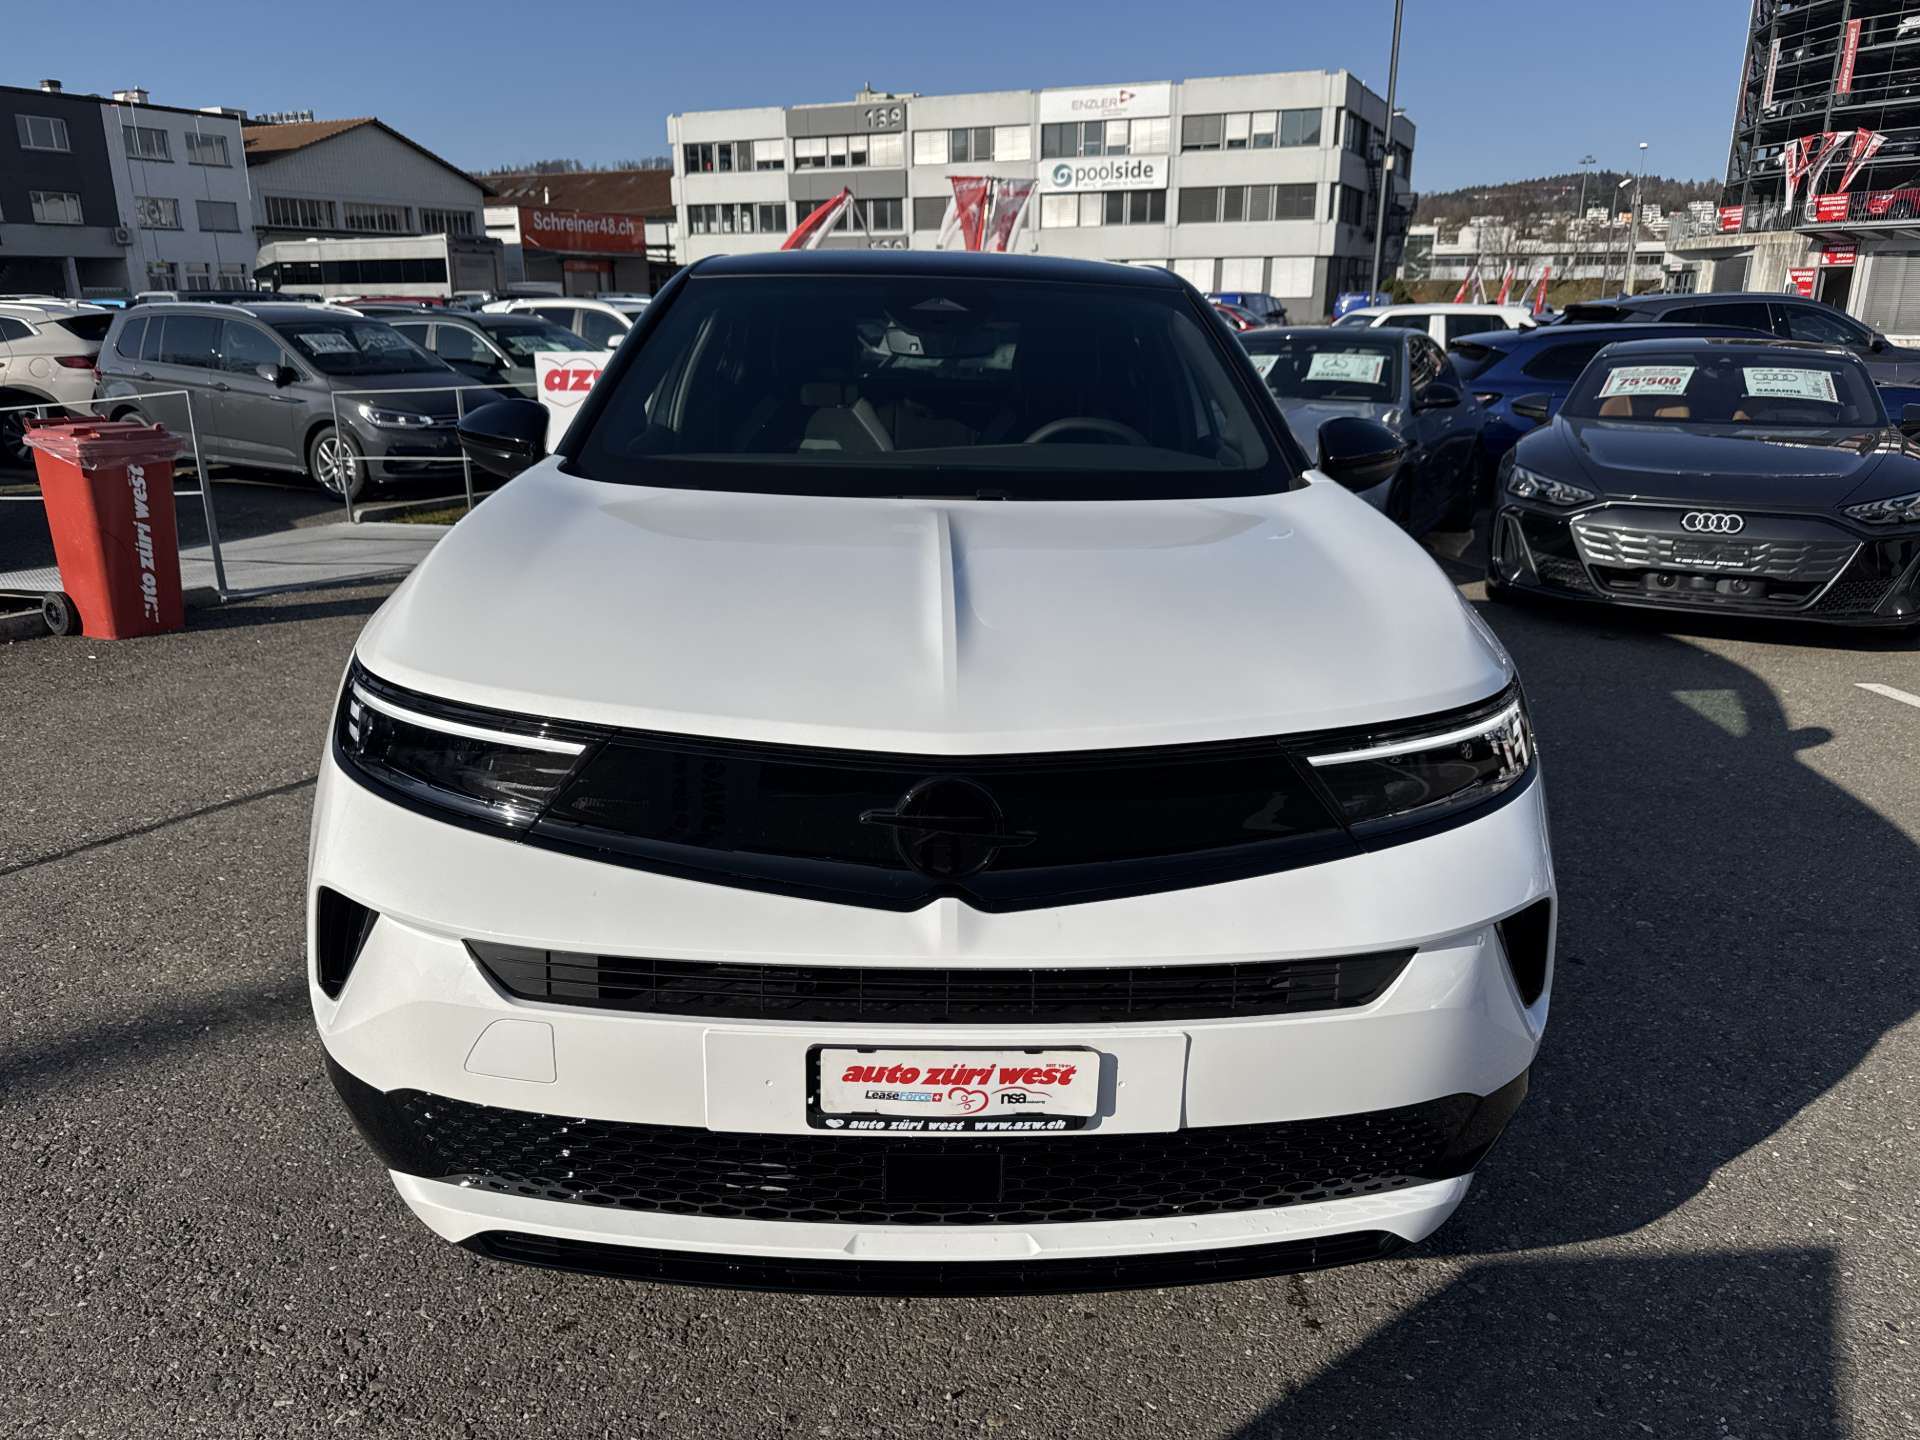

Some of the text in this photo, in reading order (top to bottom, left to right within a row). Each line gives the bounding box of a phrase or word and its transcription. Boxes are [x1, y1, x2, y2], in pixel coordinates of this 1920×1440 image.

[1071, 97, 1118, 110] ENZLER
[1075, 160, 1154, 187] poolside
[533, 211, 635, 235] Schreiner48.ch
[544, 368, 603, 391] az
[1619, 376, 1682, 386] 75'500
[128, 463, 160, 624] uto züri west
[842, 1063, 1078, 1086] auto züri west
[1001, 1093, 1027, 1104] nsa
[849, 1119, 1066, 1131] auto züri west www.azw.ch
